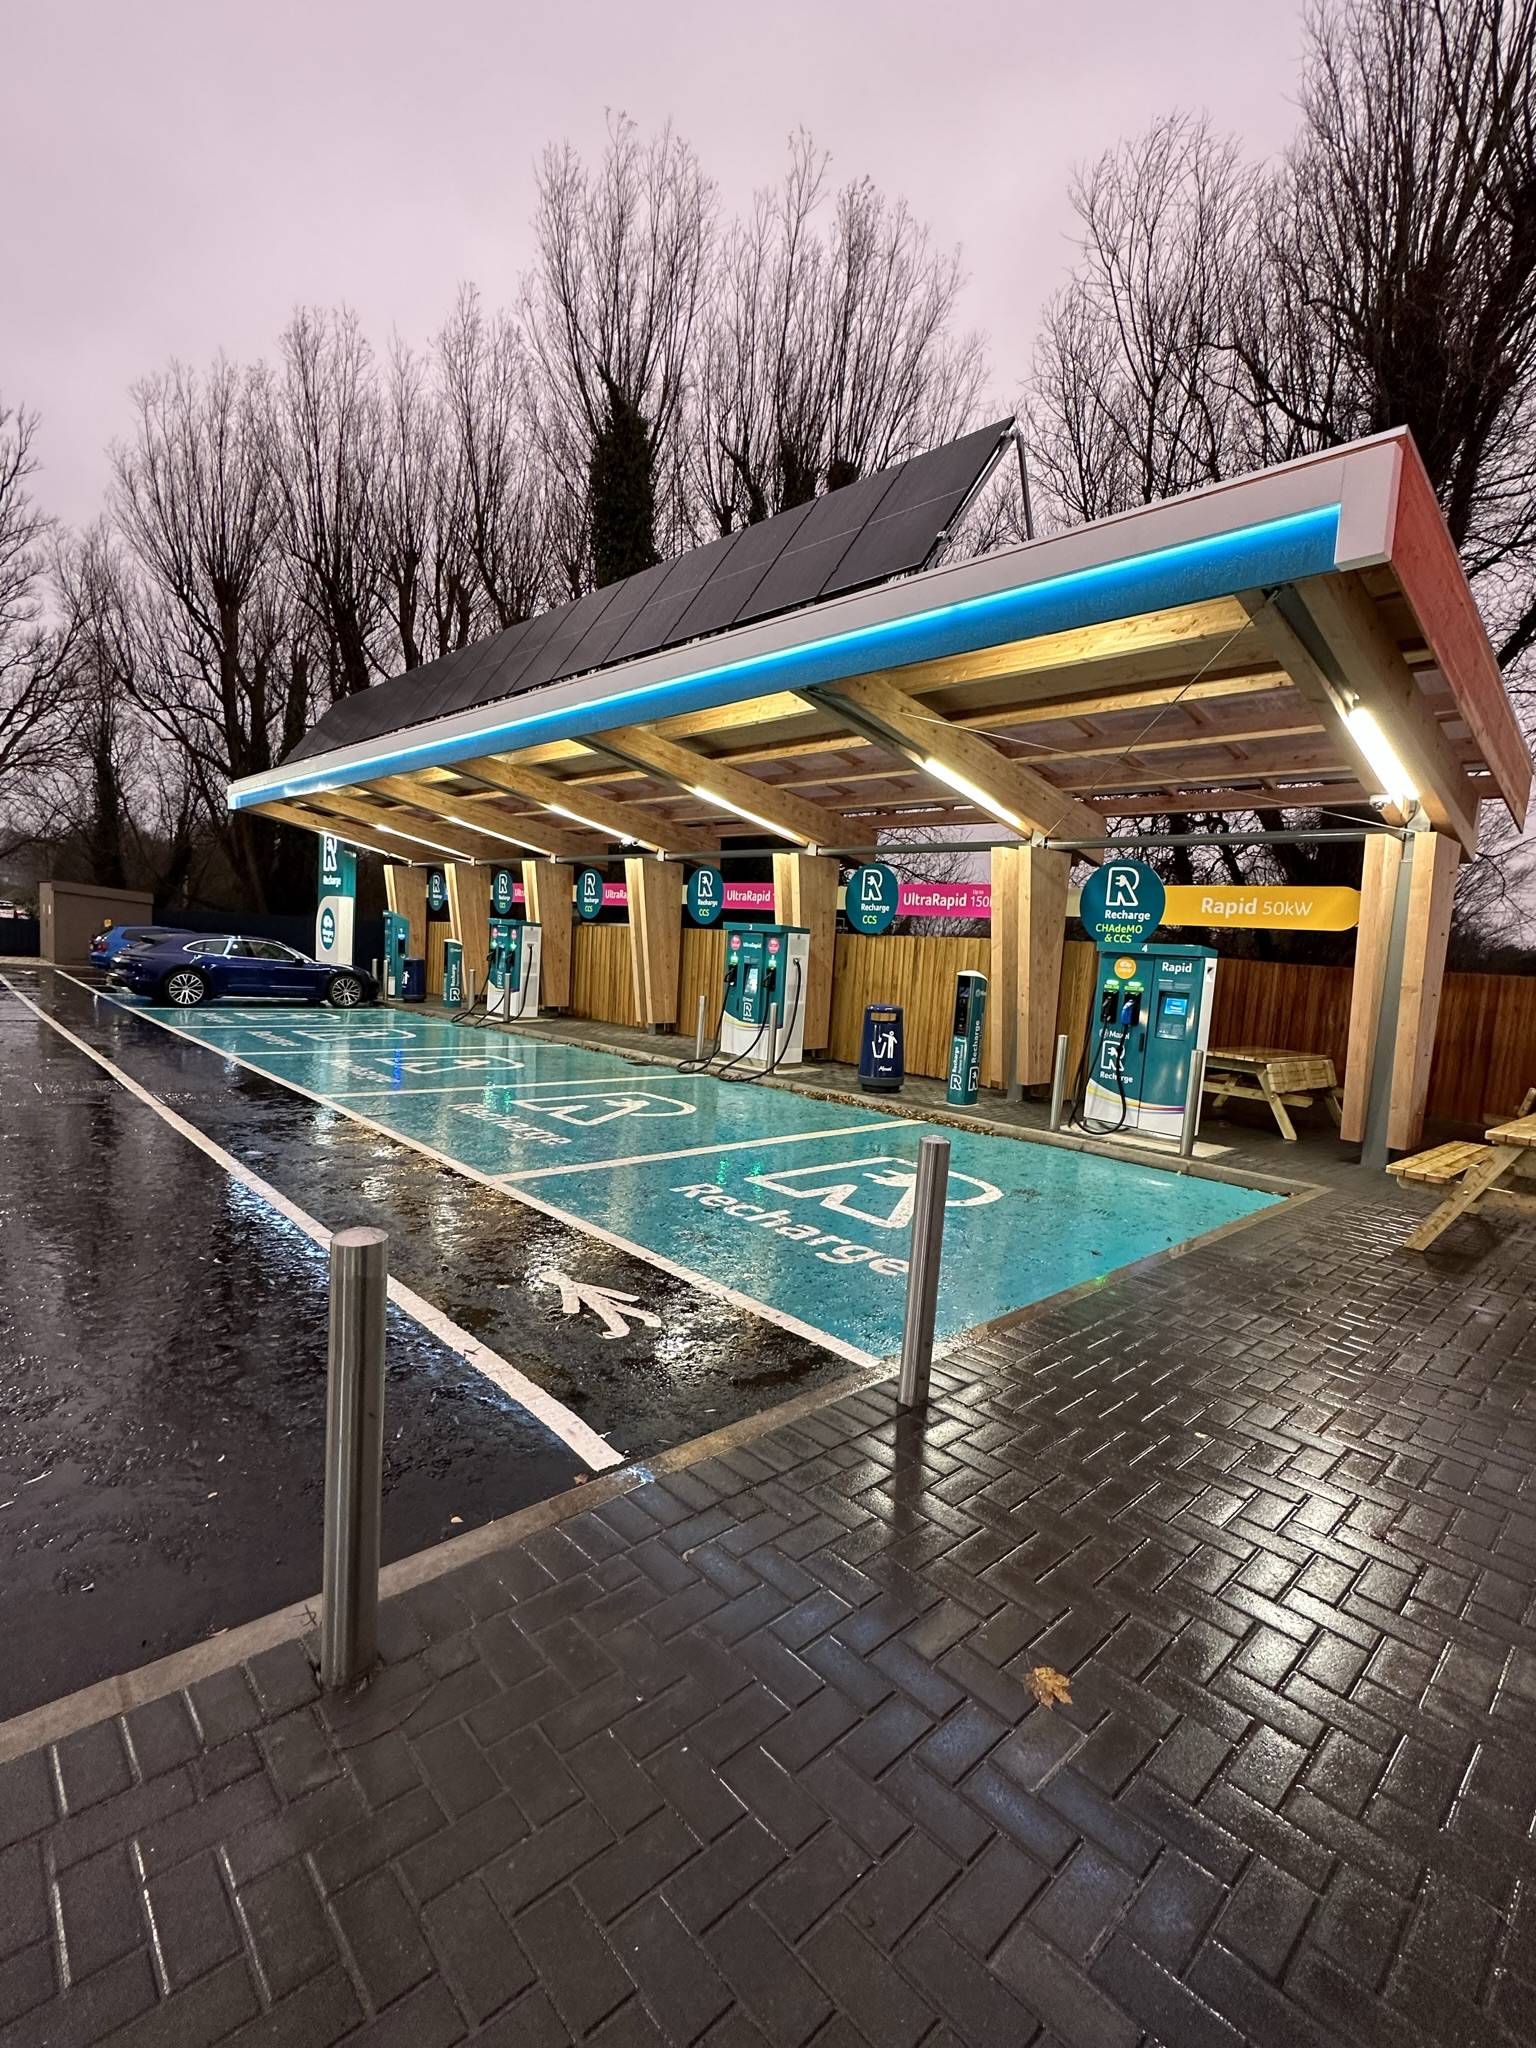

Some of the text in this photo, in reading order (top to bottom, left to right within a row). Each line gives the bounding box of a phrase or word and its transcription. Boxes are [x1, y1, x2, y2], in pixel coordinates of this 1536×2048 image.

[605, 889, 628, 900] UltraRa
[726, 889, 771, 905] UltraRapid
[903, 890, 992, 910] UltraRapid 150
[698, 908, 710, 917] CCS
[860, 902, 890, 914] Recharge
[1201, 896, 1313, 919] Rapid 50kW
[862, 915, 878, 925] CCS
[1104, 909, 1151, 923] Recharge
[1095, 923, 1143, 935] CHAdeMO
[1104, 933, 1133, 944] & CCS
[1141, 943, 1149, 953] 4
[1161, 961, 1193, 975] Rapid
[1100, 1070, 1134, 1084] Rechrge
[669, 1182, 910, 1277] Recharge
